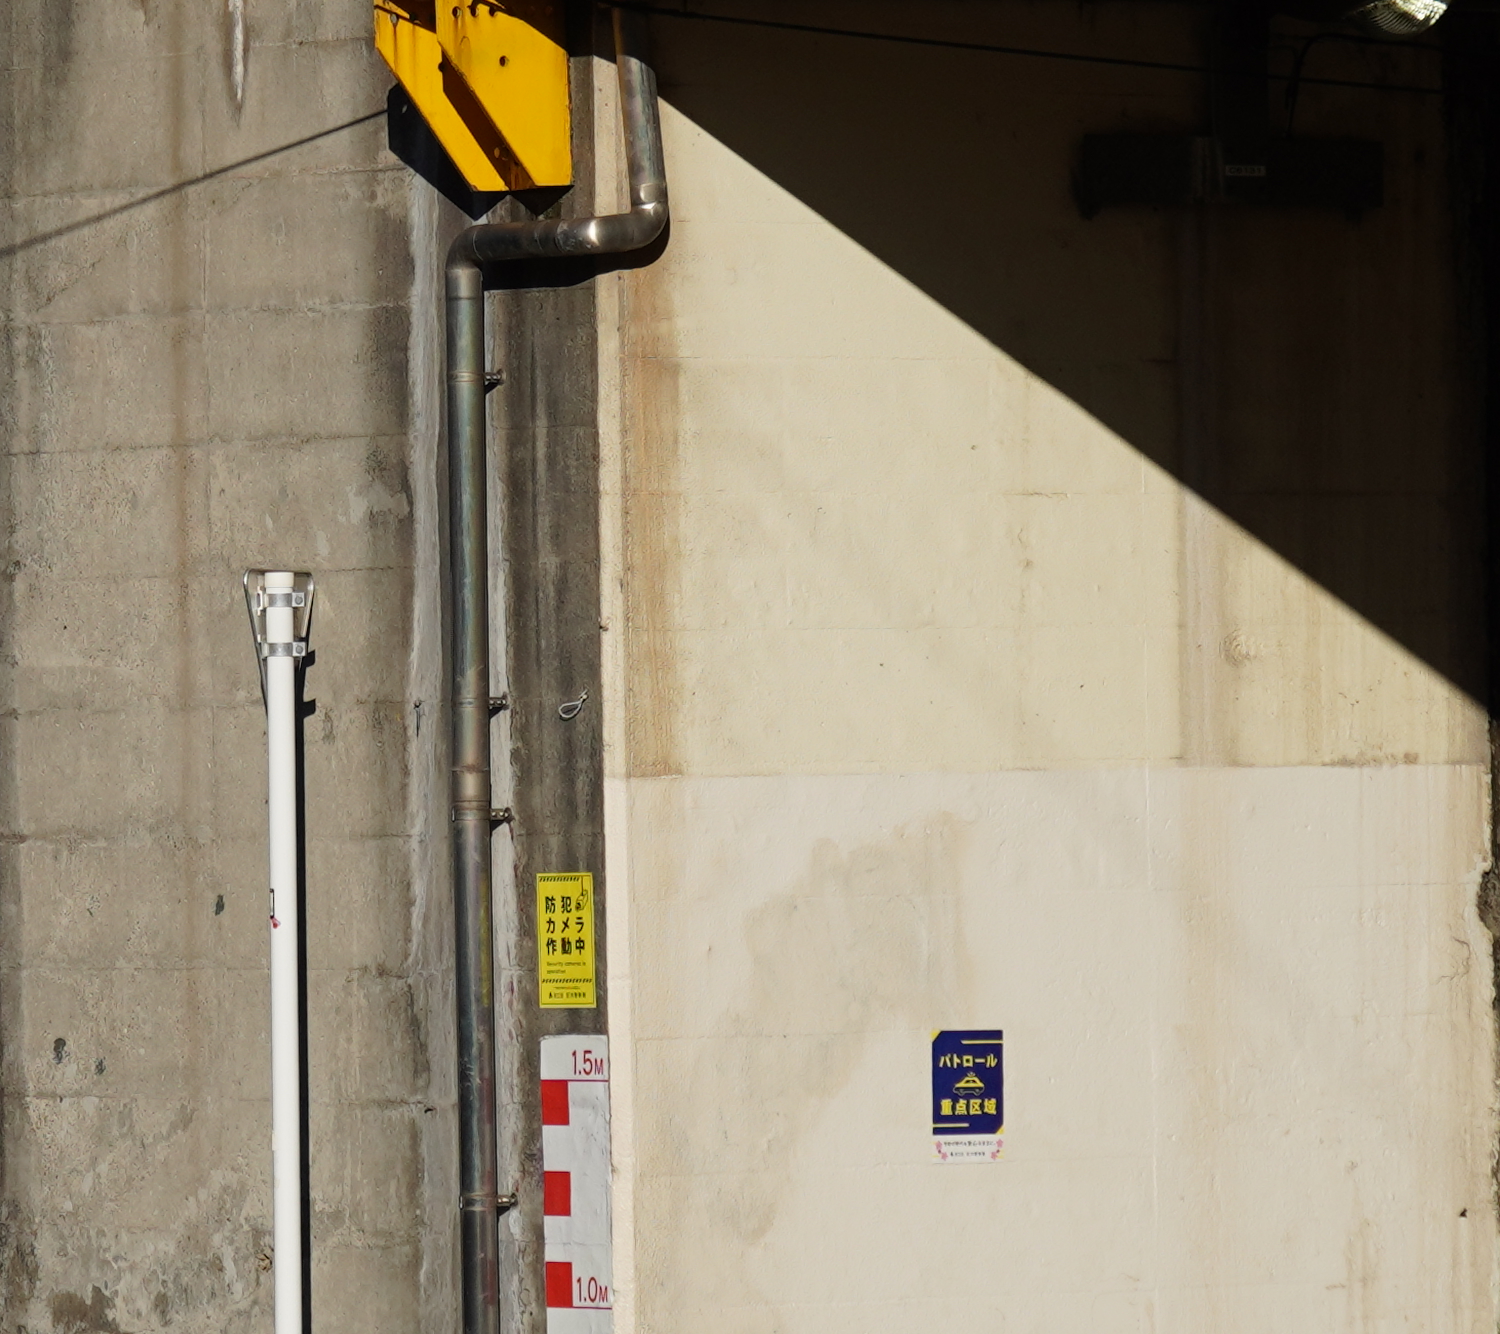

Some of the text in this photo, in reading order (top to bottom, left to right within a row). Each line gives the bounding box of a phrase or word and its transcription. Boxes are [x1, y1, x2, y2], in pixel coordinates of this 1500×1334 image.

[545, 896, 572, 914] 防犯
[546, 917, 585, 934] カメラ
[546, 937, 586, 956] 作動中
[571, 1049, 604, 1075] 1.5M
[939, 1053, 998, 1068] パトロール
[940, 1098, 997, 1115] 重点区域
[576, 1276, 608, 1303] 1.0M
